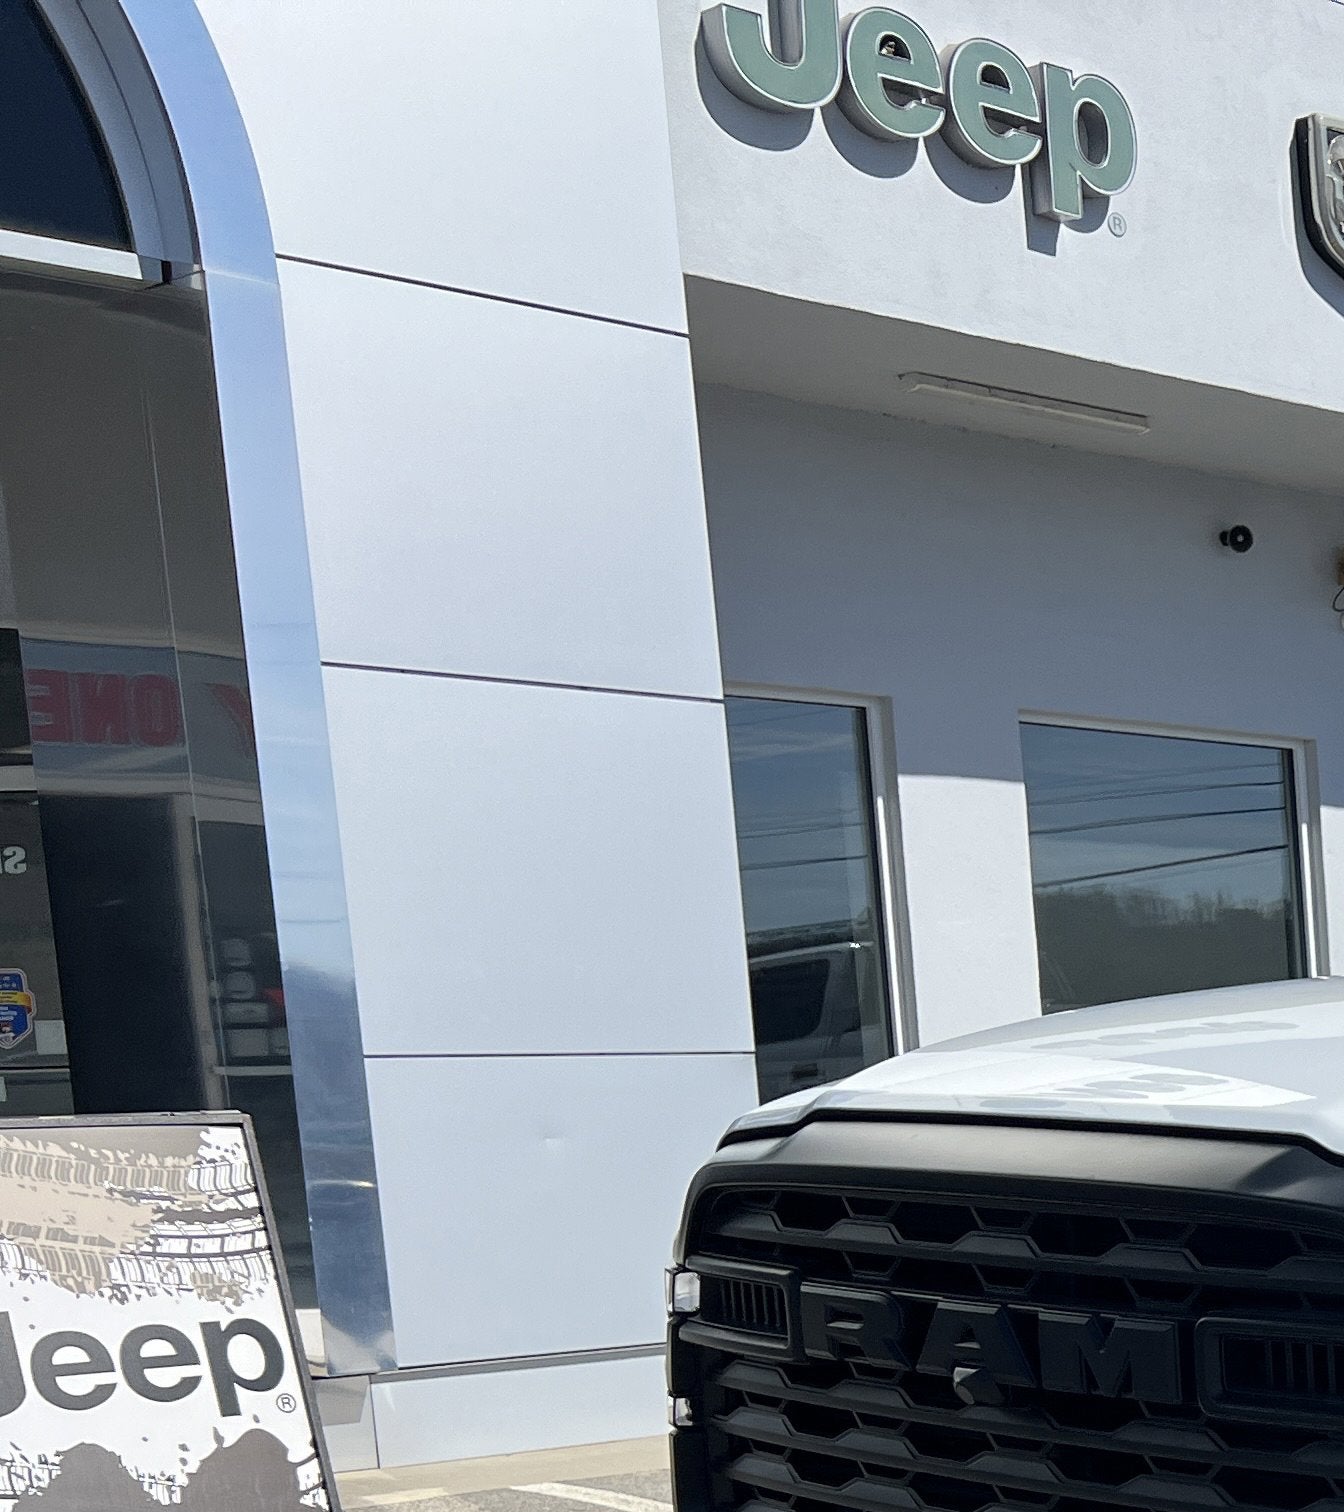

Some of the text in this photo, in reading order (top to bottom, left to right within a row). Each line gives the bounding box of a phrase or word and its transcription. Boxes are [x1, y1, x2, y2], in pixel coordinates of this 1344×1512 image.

[700, 0, 1137, 221] Jeep
[0, 1310, 285, 1418] eep
[800, 1282, 1182, 1404] RAM
